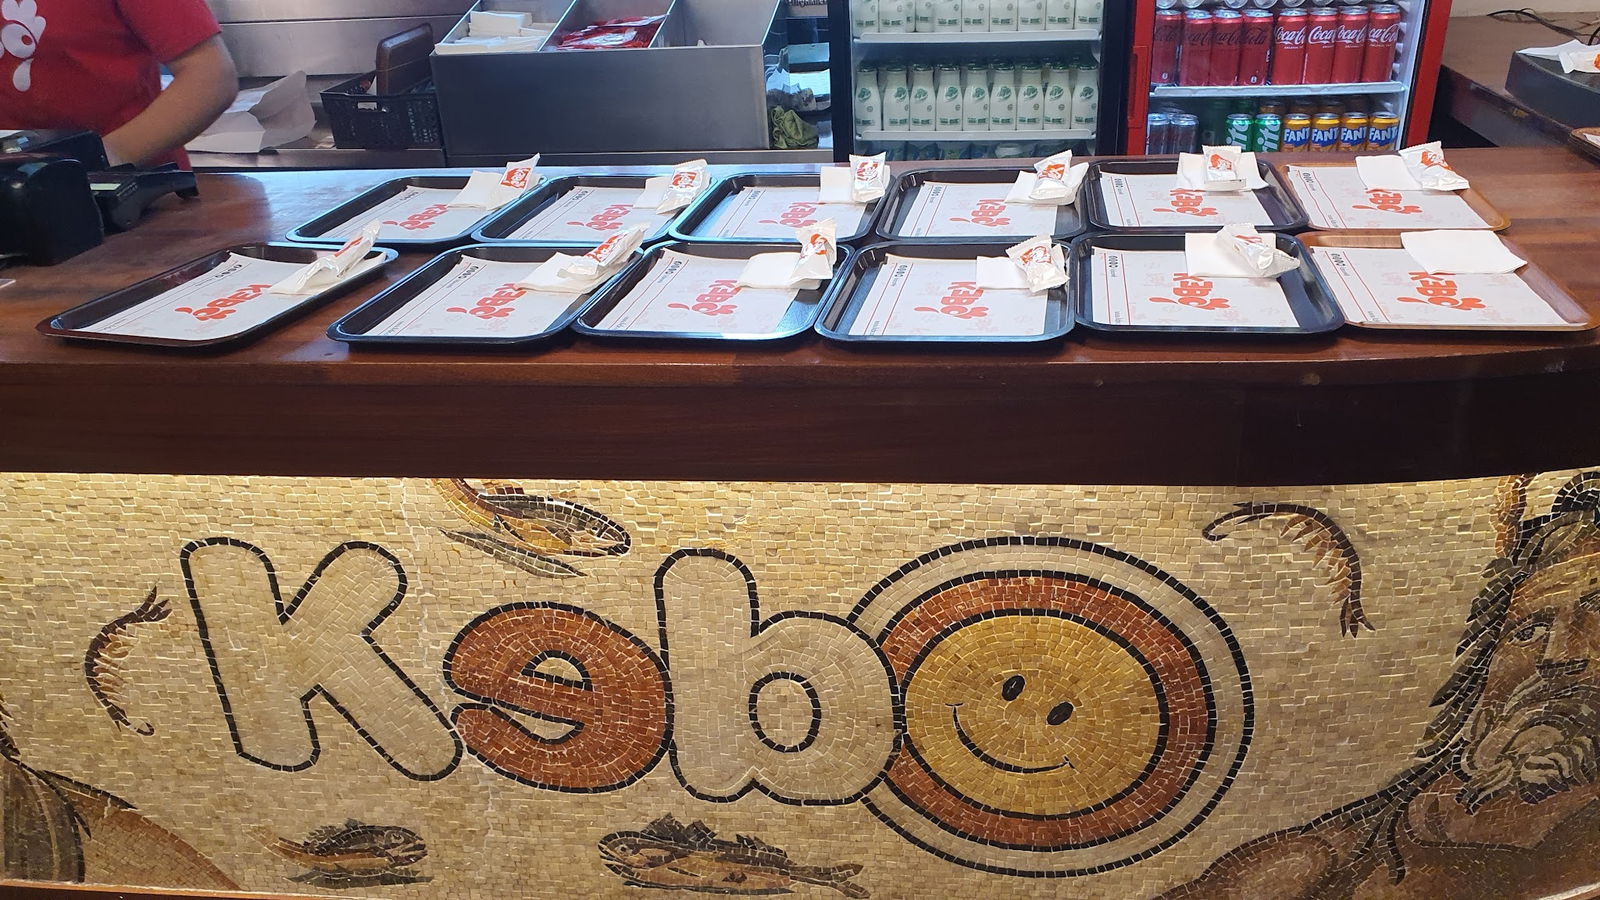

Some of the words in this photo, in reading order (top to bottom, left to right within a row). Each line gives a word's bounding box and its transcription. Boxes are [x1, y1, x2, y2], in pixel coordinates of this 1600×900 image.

[971, 199, 1010, 227] KEBO
[691, 279, 742, 316] KEBO
[940, 281, 989, 319] KEBO
